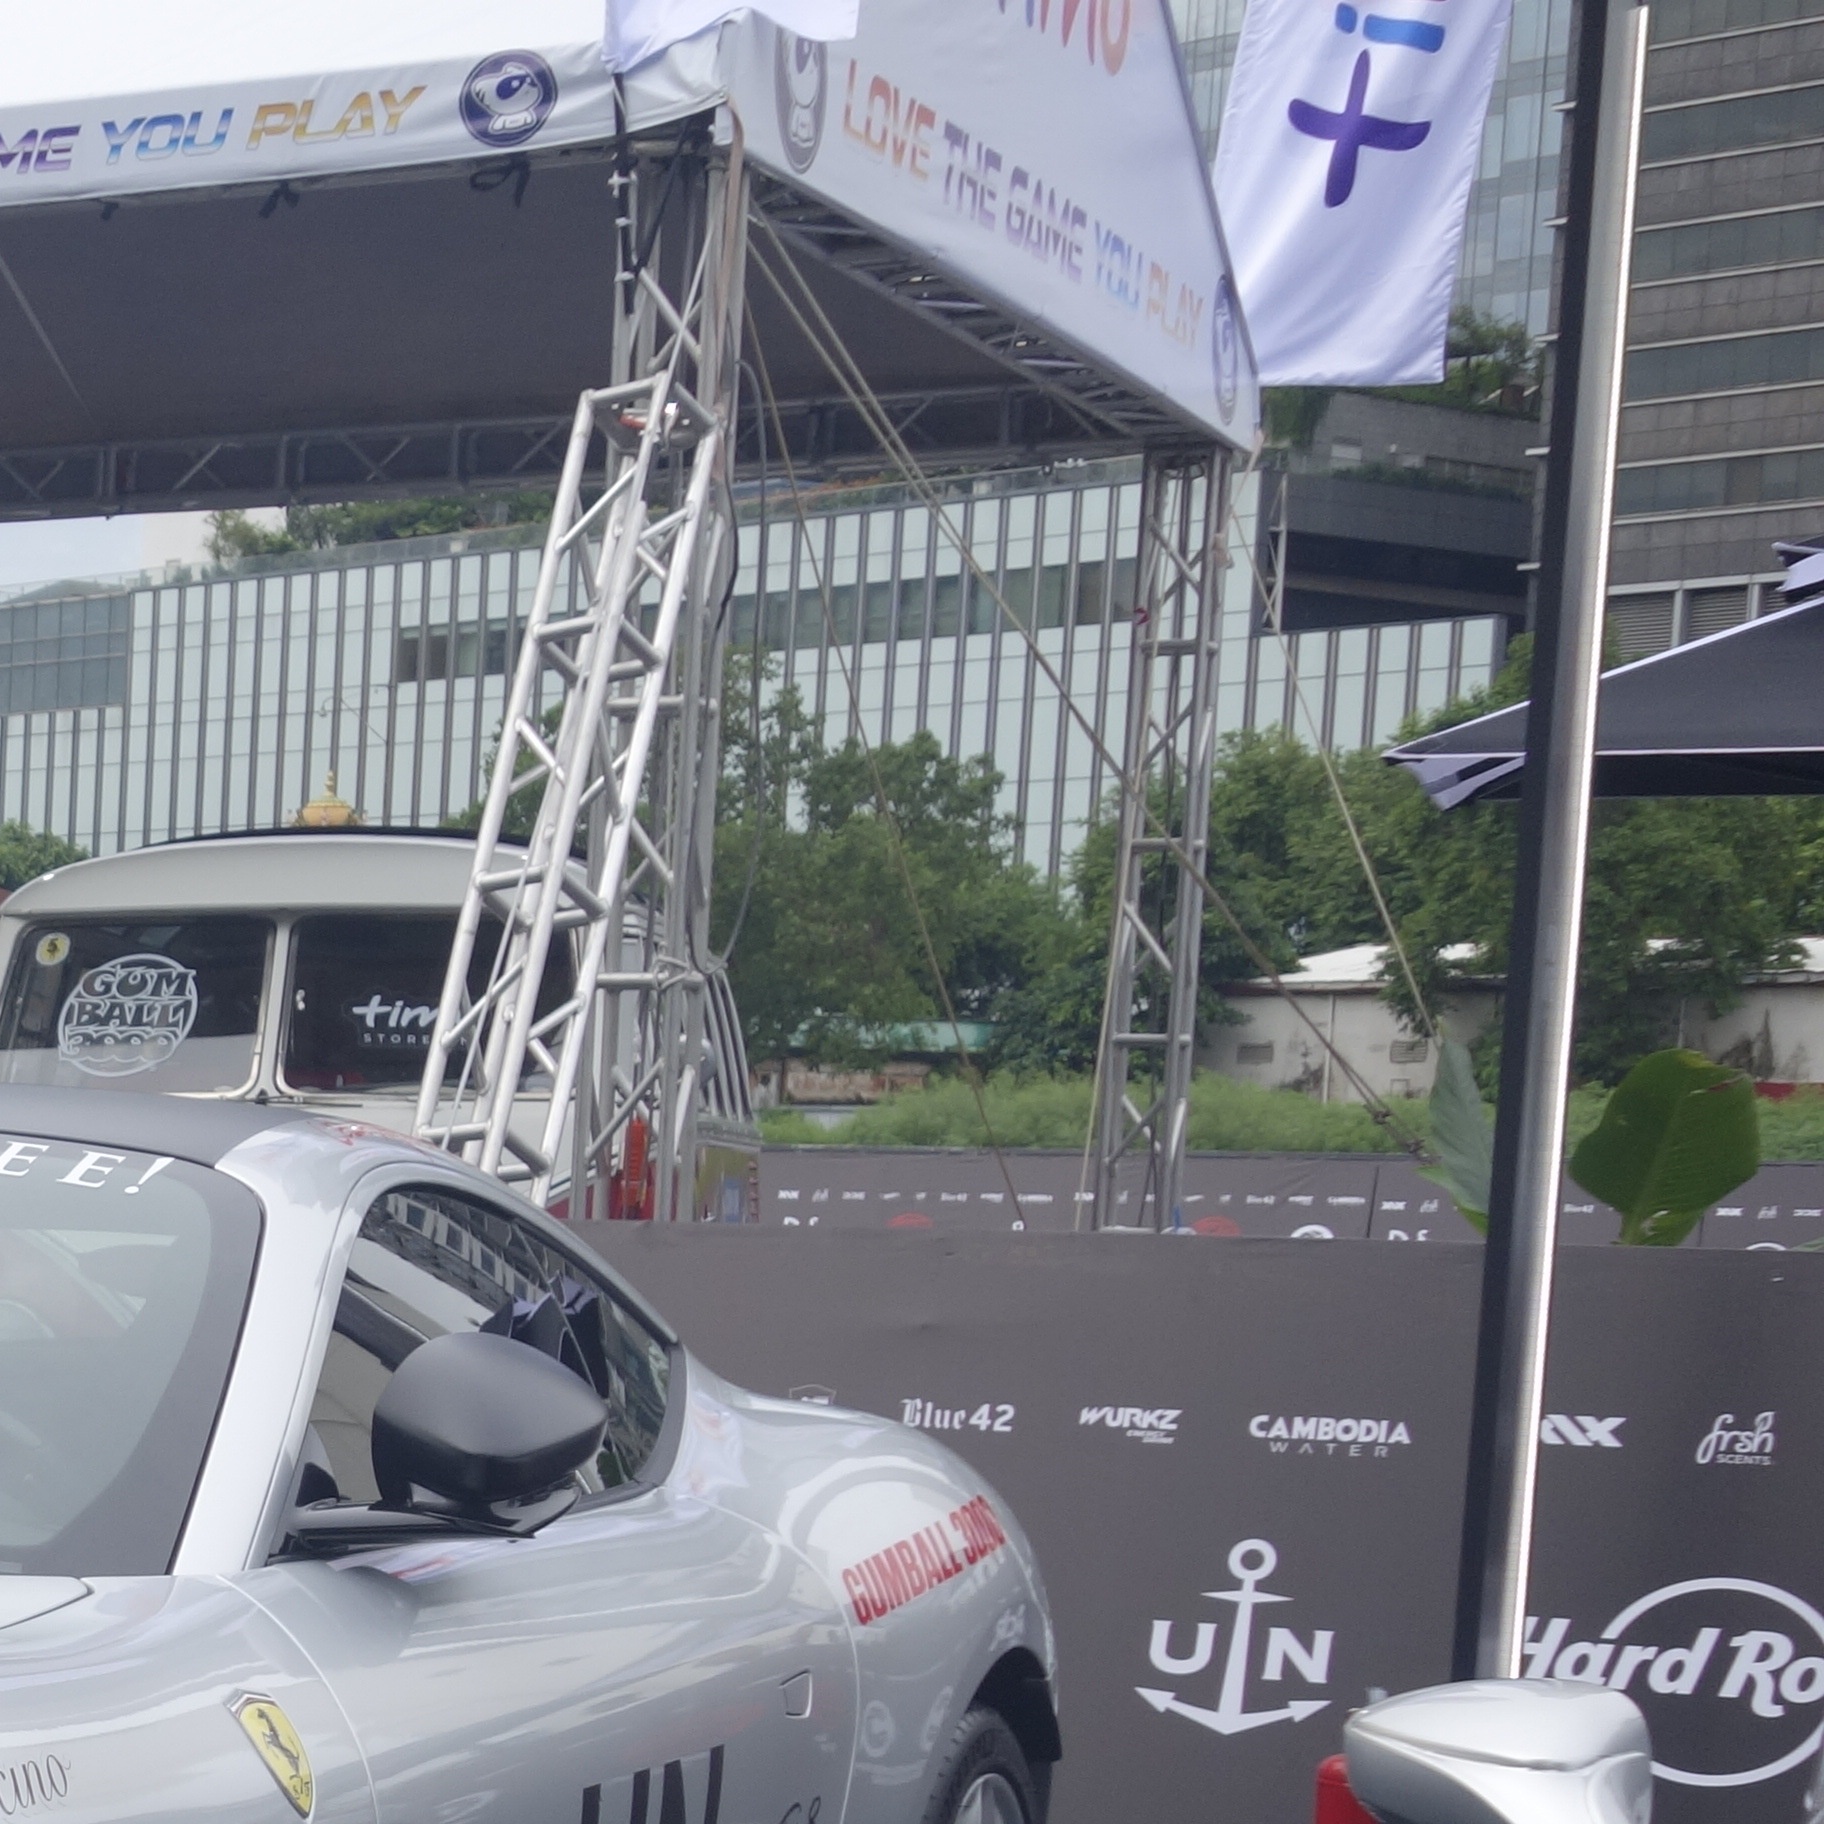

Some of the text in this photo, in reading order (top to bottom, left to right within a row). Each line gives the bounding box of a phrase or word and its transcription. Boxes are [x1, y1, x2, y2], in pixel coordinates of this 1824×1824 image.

[100, 106, 235, 165] YOU
[245, 85, 428, 148] PLAY
[843, 58, 1205, 351] LOVE THE GAME YOU PLAY
[81, 964, 197, 999] GUM
[67, 998, 186, 1031] BALL
[351, 993, 442, 1028] tim
[363, 1032, 431, 1047] STORE
[1079, 1405, 1183, 1430] WURKZ
[1249, 1414, 1412, 1444] CAMBODIA
[1269, 1441, 1390, 1458] WATER
[841, 1520, 964, 1626] GUMBALL
[1719, 1629, 1824, 1717] Ro
